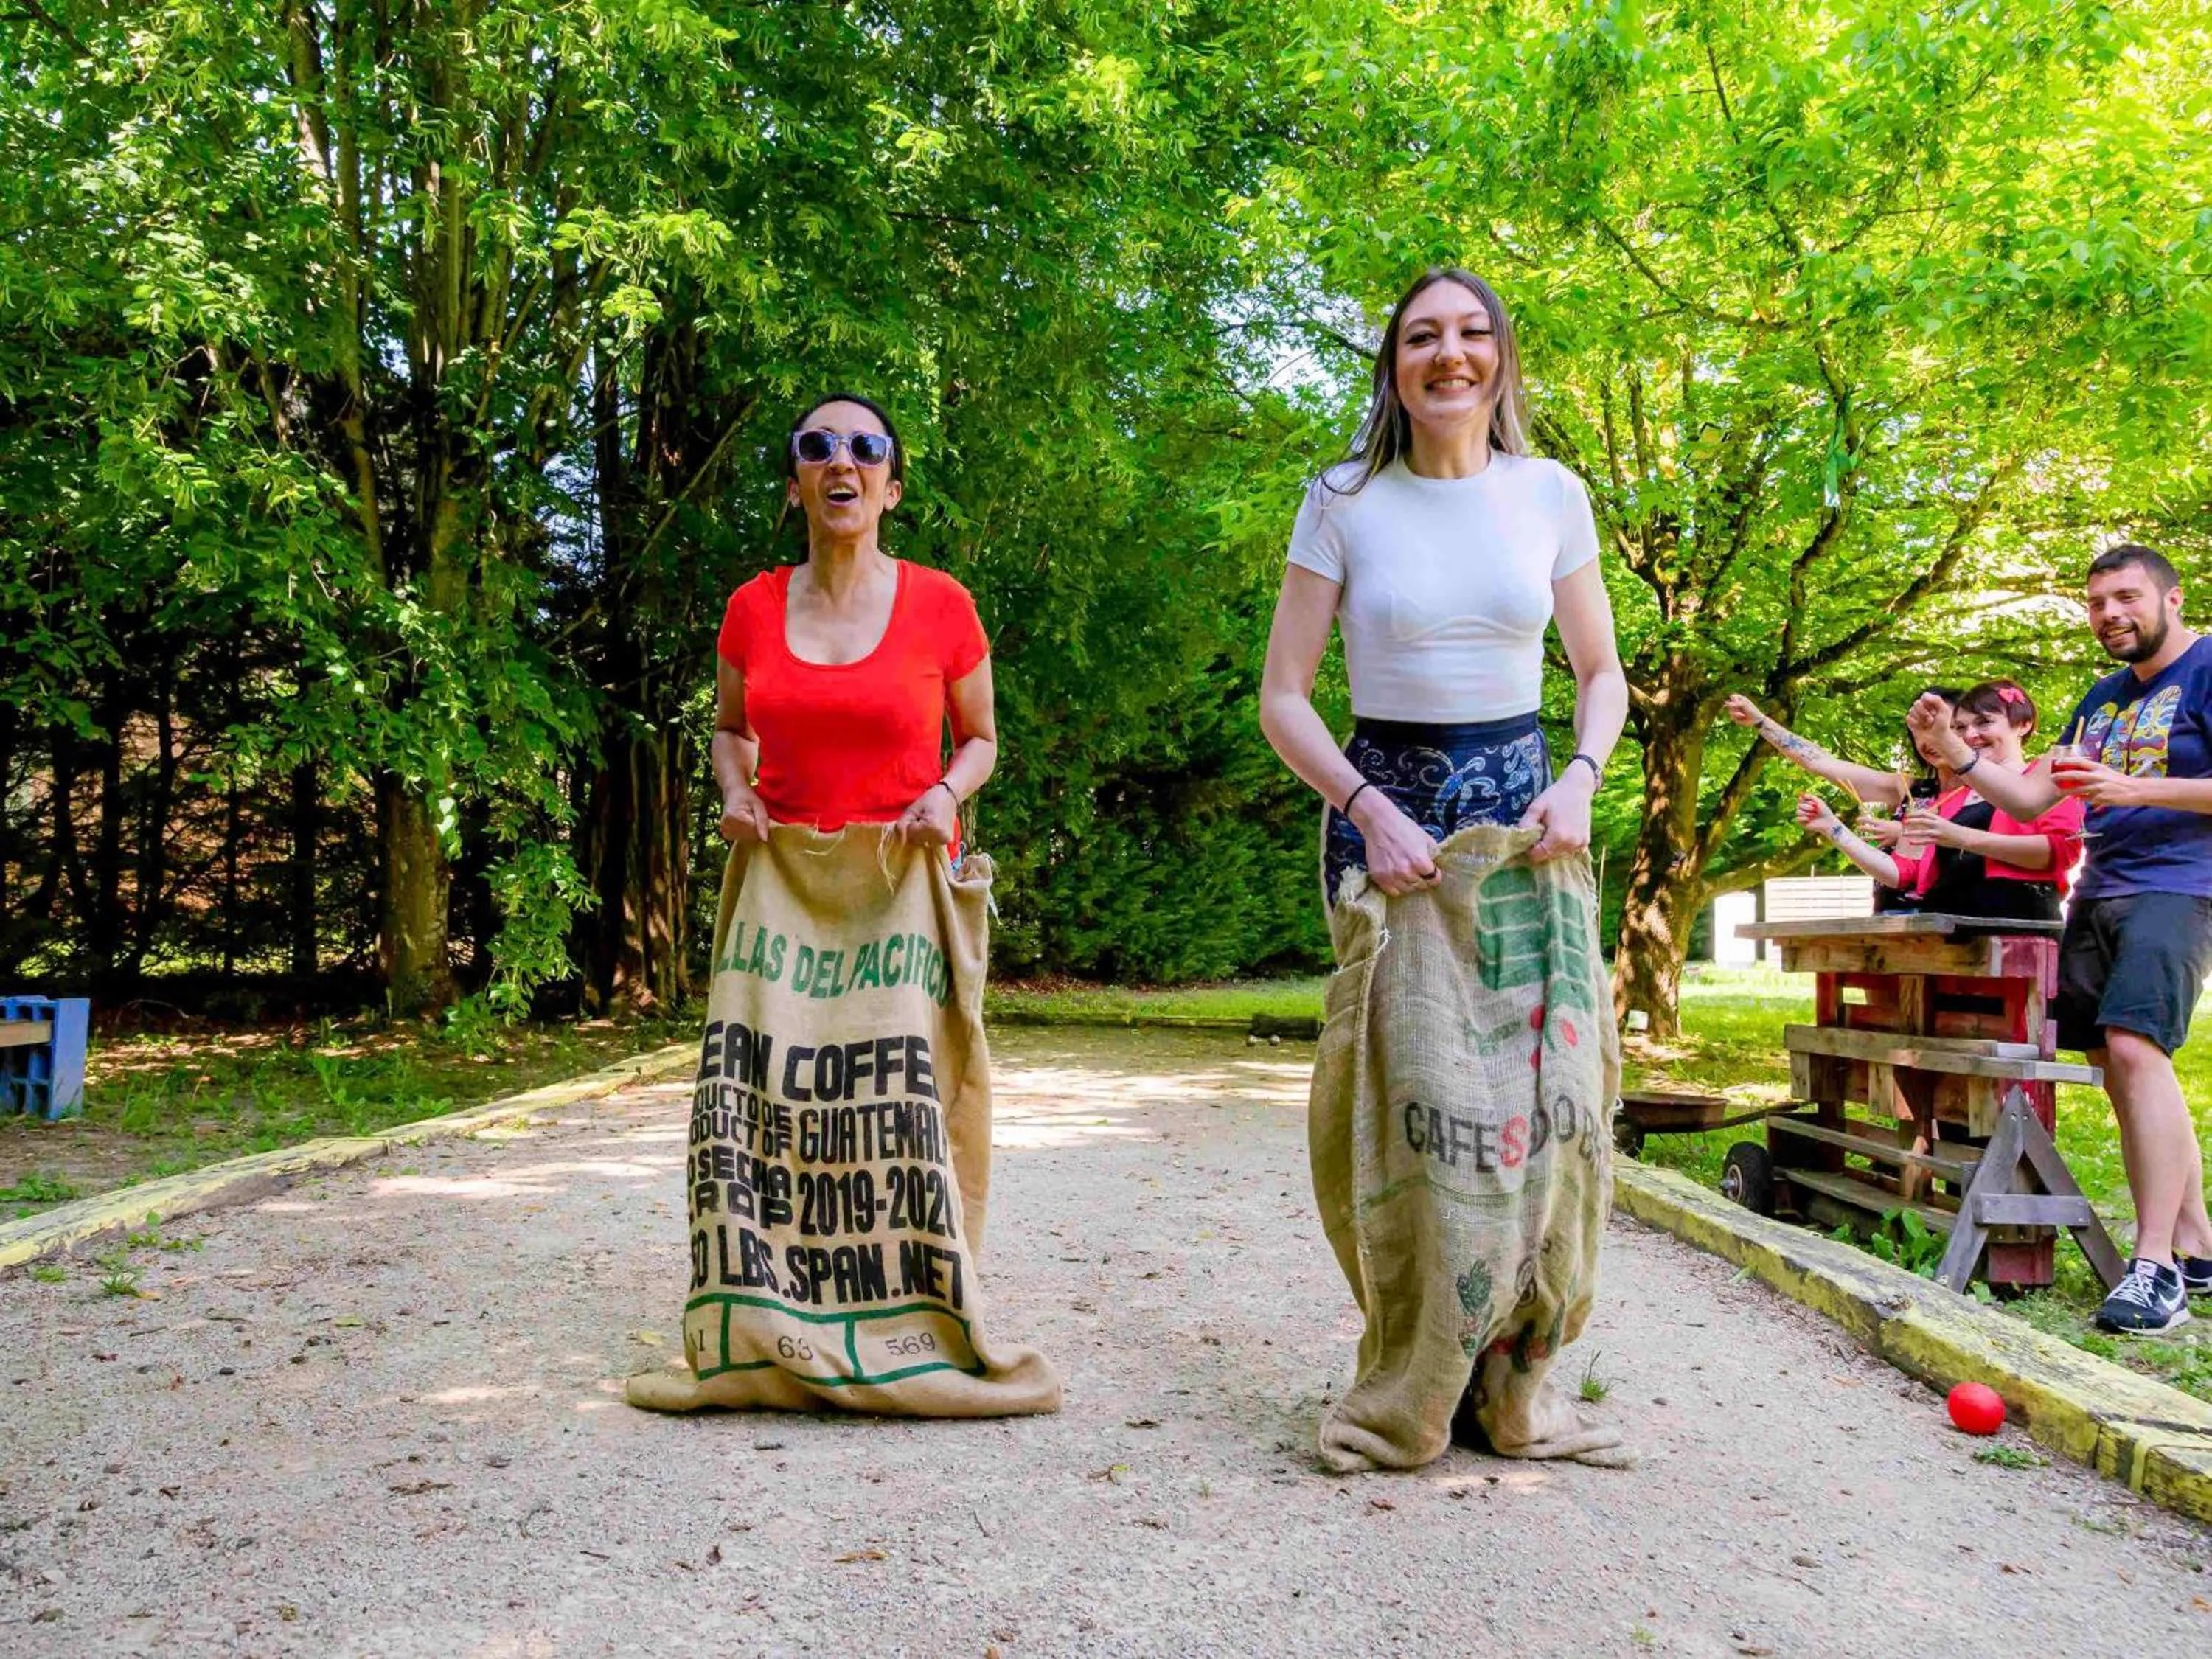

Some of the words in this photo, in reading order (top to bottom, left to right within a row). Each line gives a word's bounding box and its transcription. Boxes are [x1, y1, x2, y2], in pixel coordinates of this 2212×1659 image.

[791, 945, 844, 998] DEL
[696, 1020, 773, 1093] EAN
[782, 1034, 940, 1102] COFFE
[762, 1098, 792, 1131] DE
[799, 1101, 947, 1164] GUATEMAL
[1404, 1101, 1529, 1173] CAFES
[762, 1129, 792, 1158] OF
[688, 1180, 793, 1231] ROP
[777, 1335, 813, 1360] 63
[885, 1332, 936, 1356] 569
